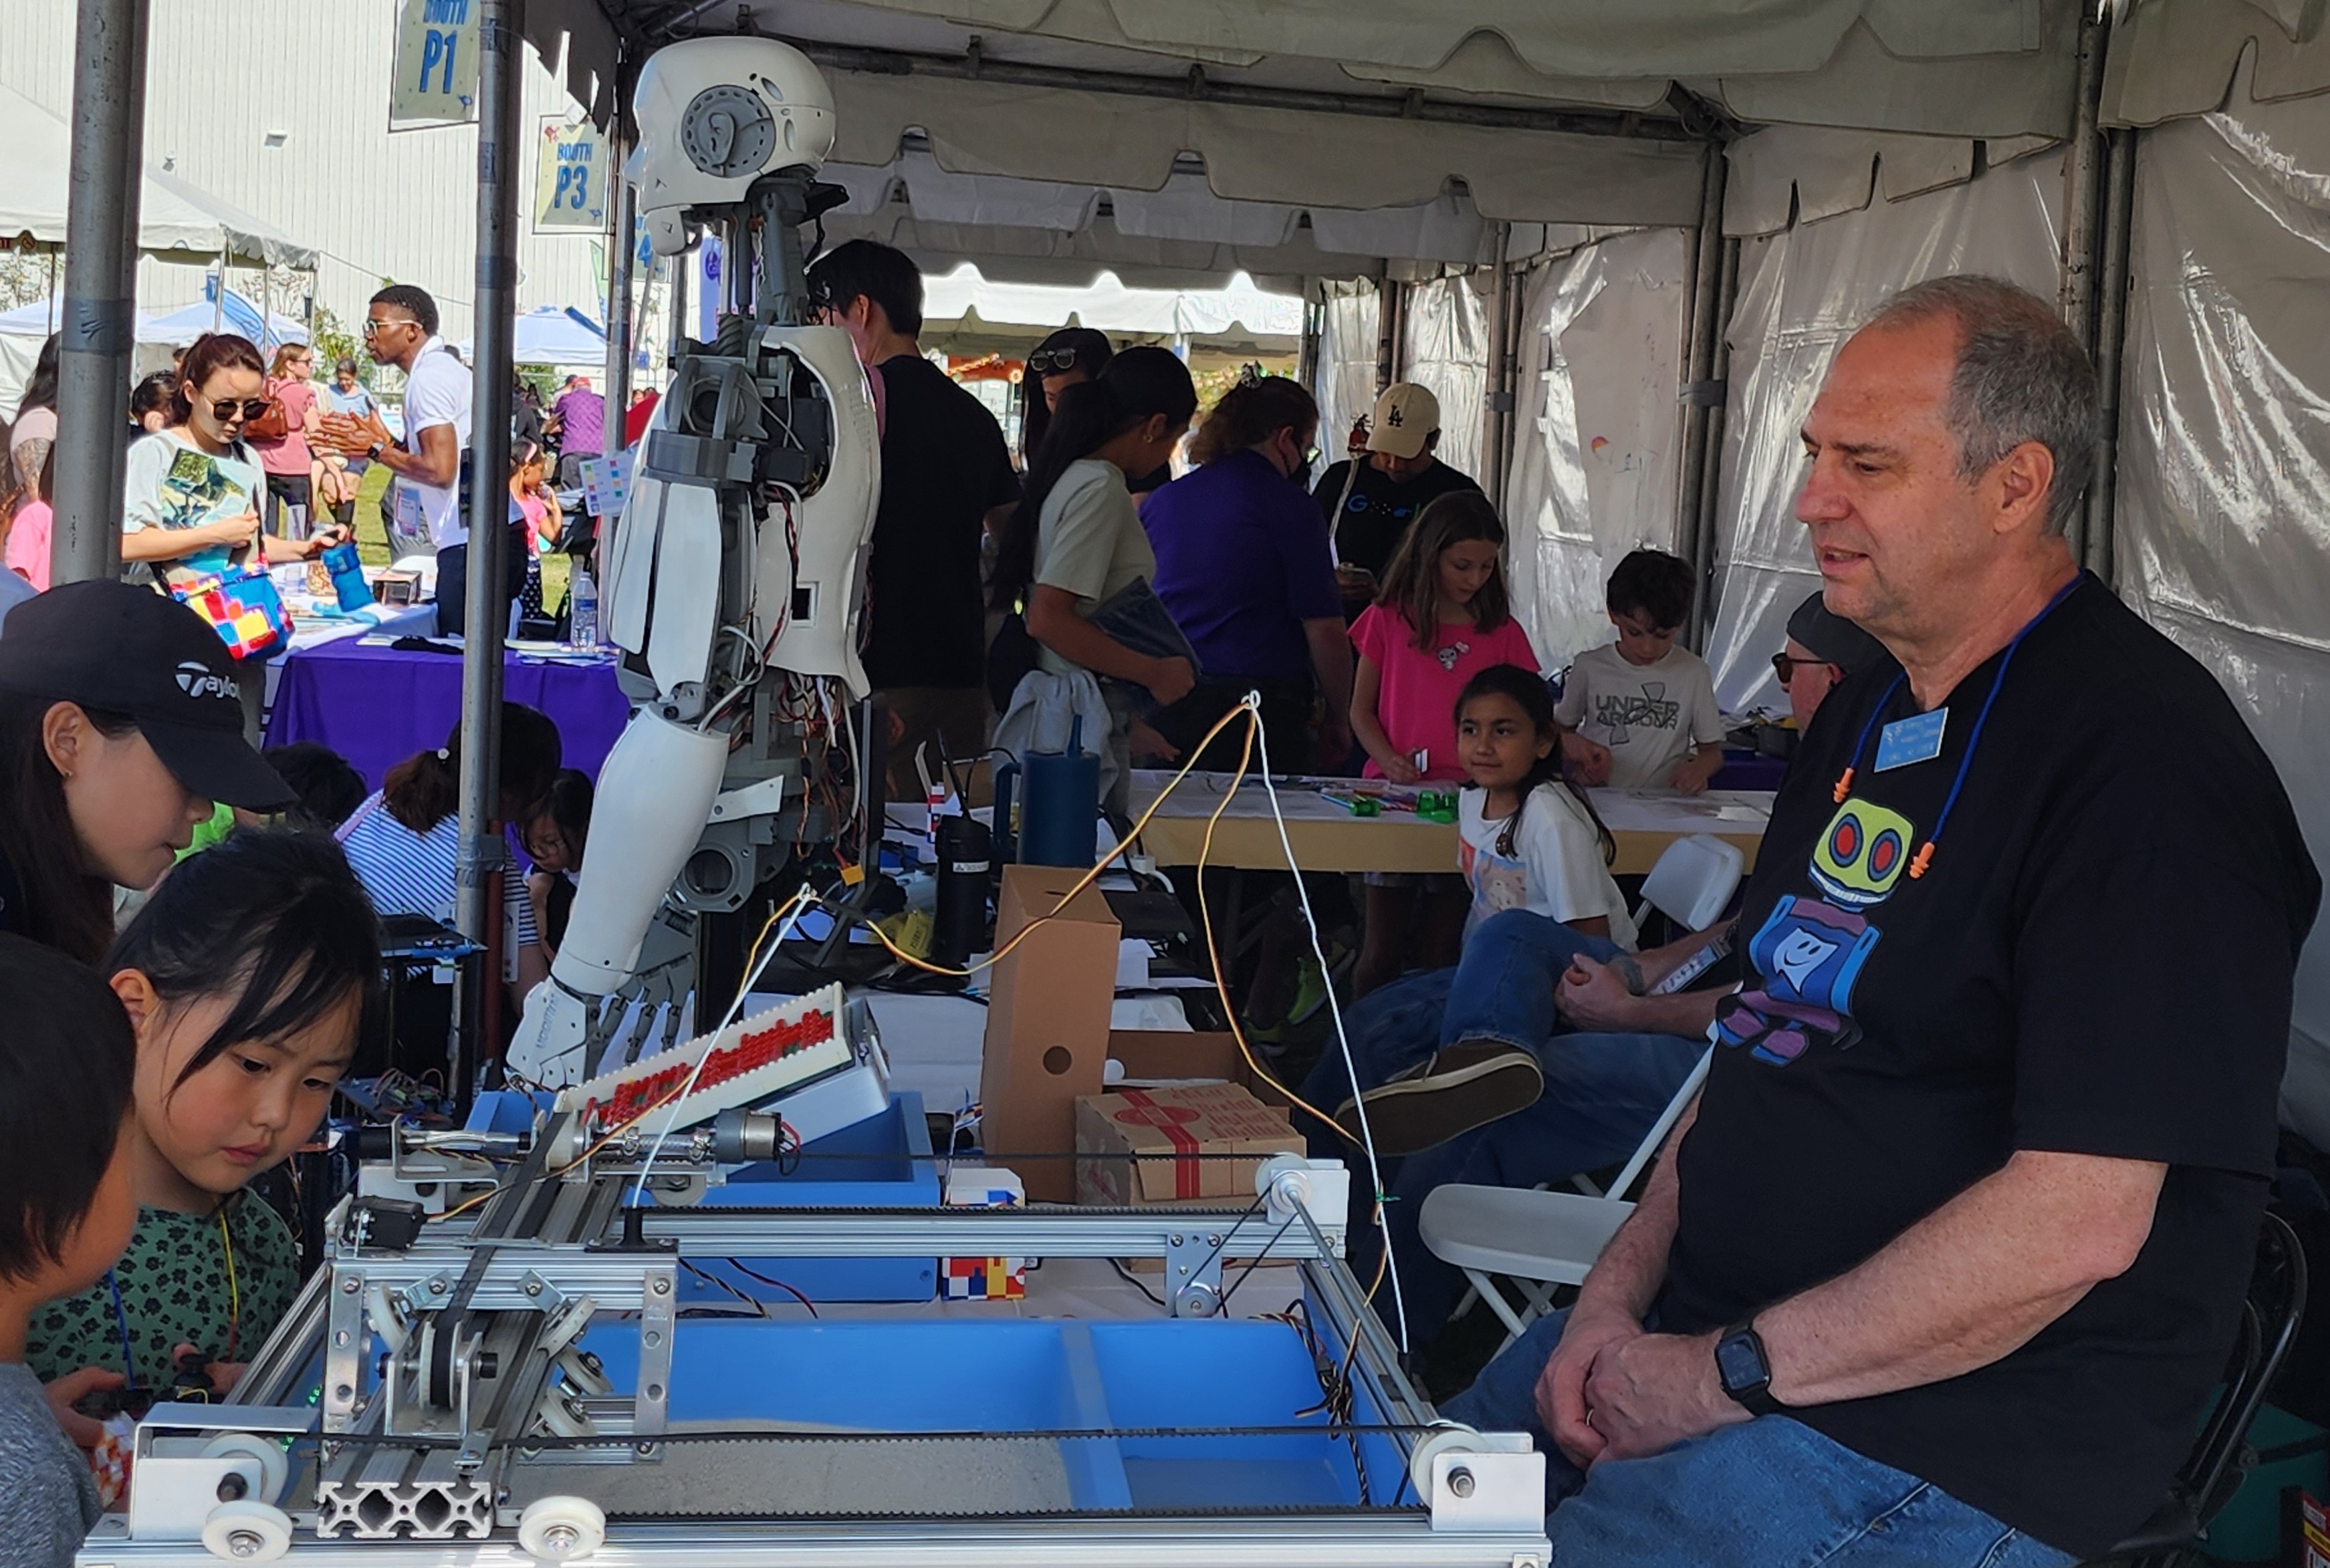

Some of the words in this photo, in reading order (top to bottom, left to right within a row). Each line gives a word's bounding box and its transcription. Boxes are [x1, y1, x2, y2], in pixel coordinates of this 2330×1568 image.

[423, 0, 467, 25] BOOTH
[419, 29, 457, 94] P1
[557, 142, 593, 161] BOOTH
[554, 164, 588, 210] P3
[634, 235, 653, 268] 4
[1388, 404, 1403, 428] LA
[175, 661, 241, 698] Taylo
[1596, 694, 1679, 716] UNDER
[1597, 710, 1678, 730] AROUR
